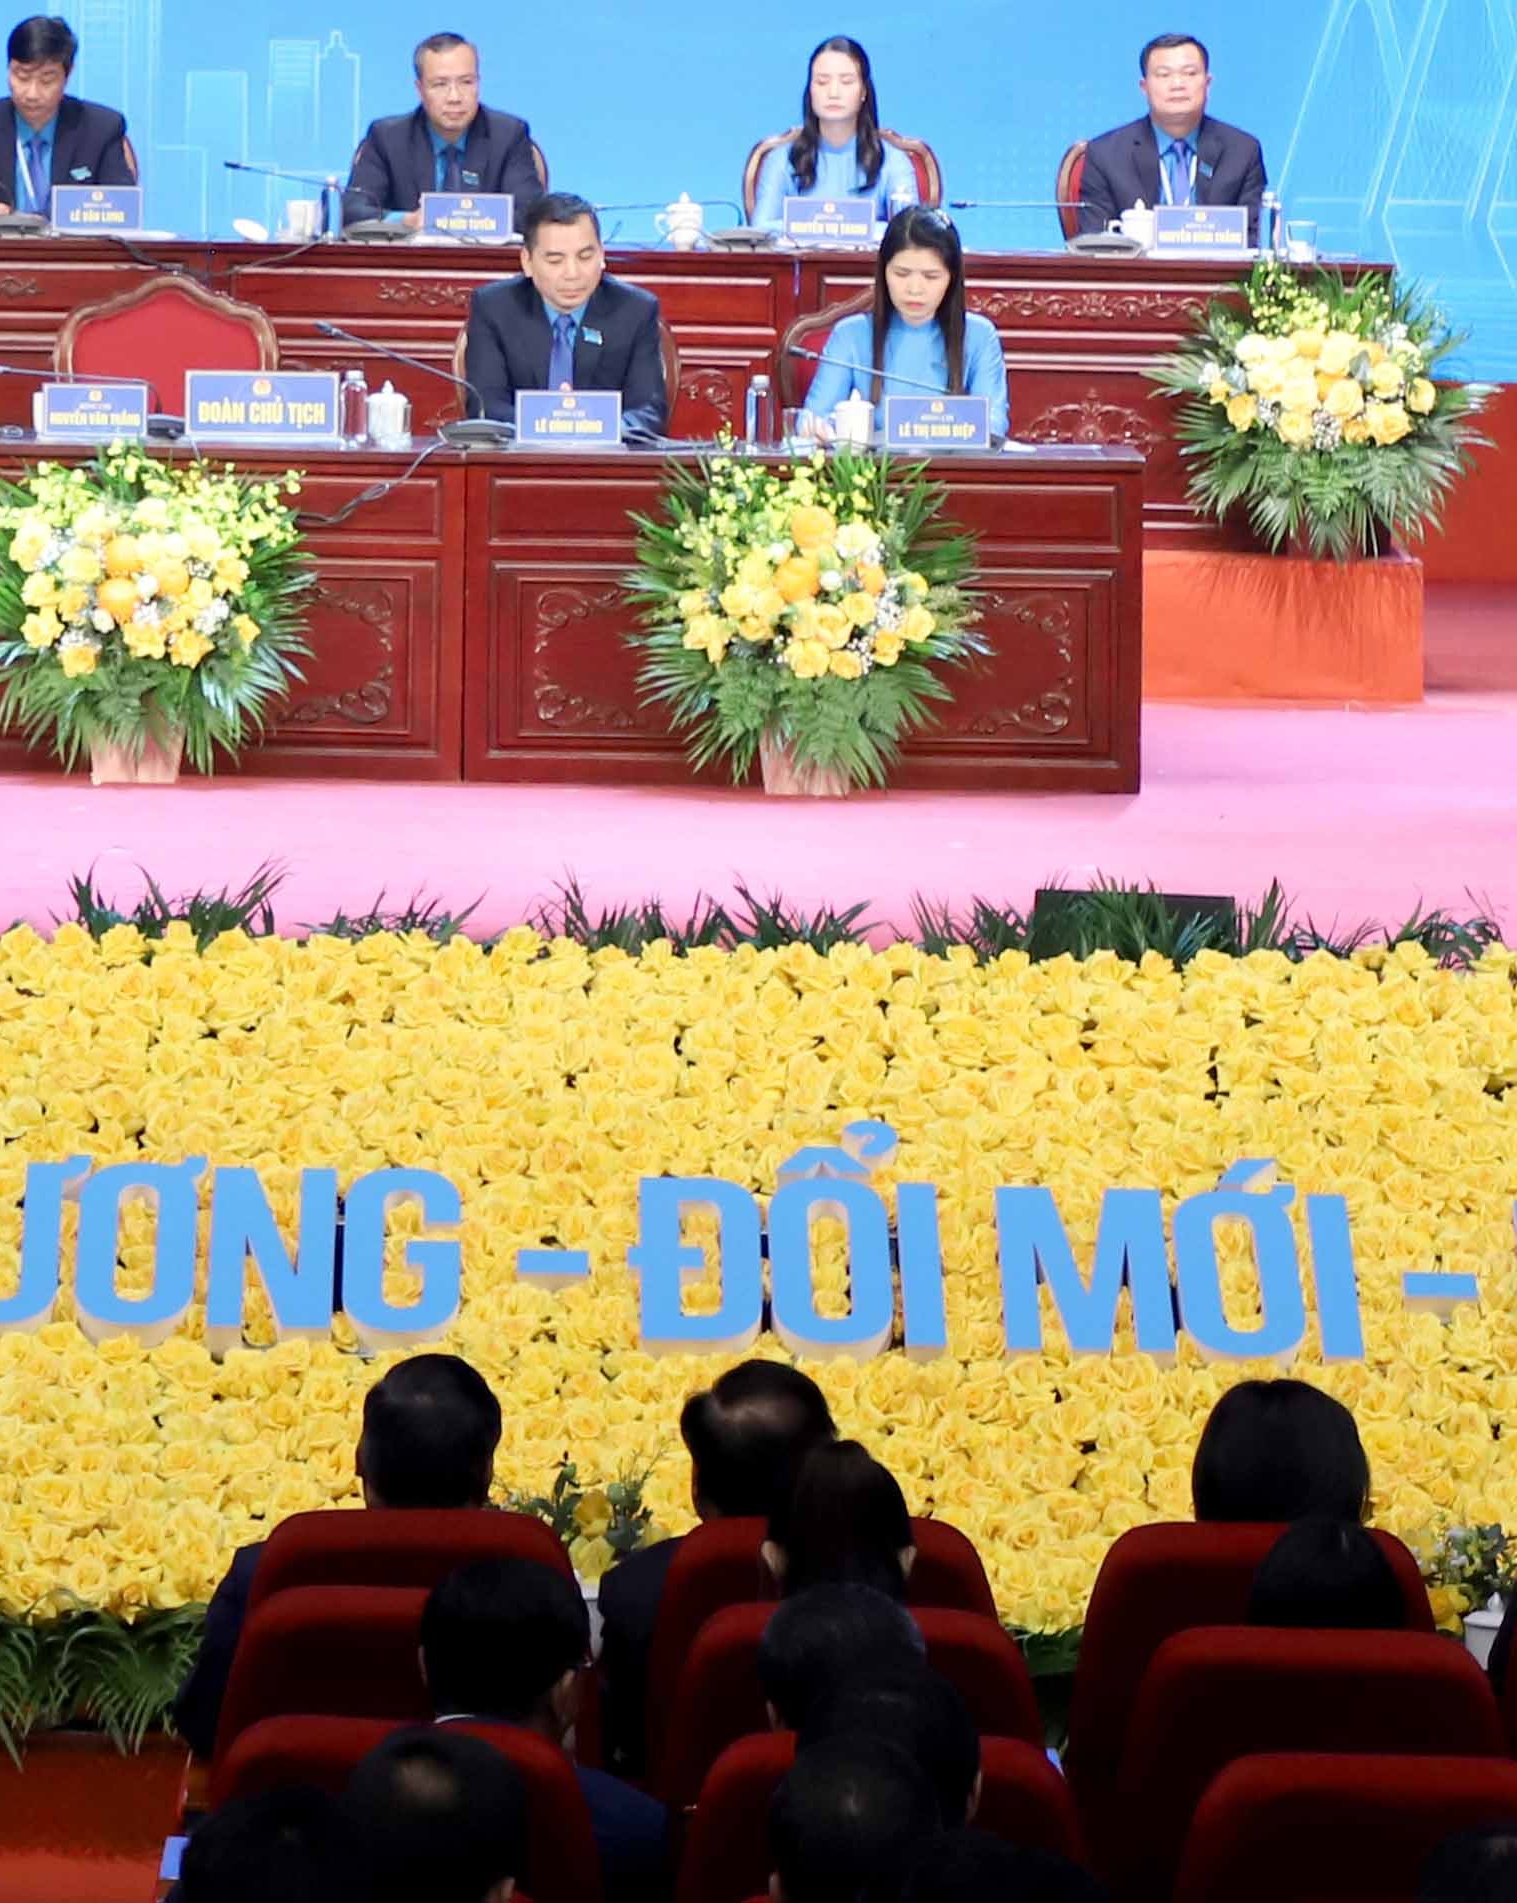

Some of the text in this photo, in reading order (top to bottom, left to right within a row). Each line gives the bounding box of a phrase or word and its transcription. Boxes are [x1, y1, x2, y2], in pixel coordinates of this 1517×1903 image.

[198, 396, 326, 429] ĐOÀN CHỦ TỊCH
[627, 1120, 947, 1352] ĐỔI
[996, 1159, 1364, 1360] MỚI
